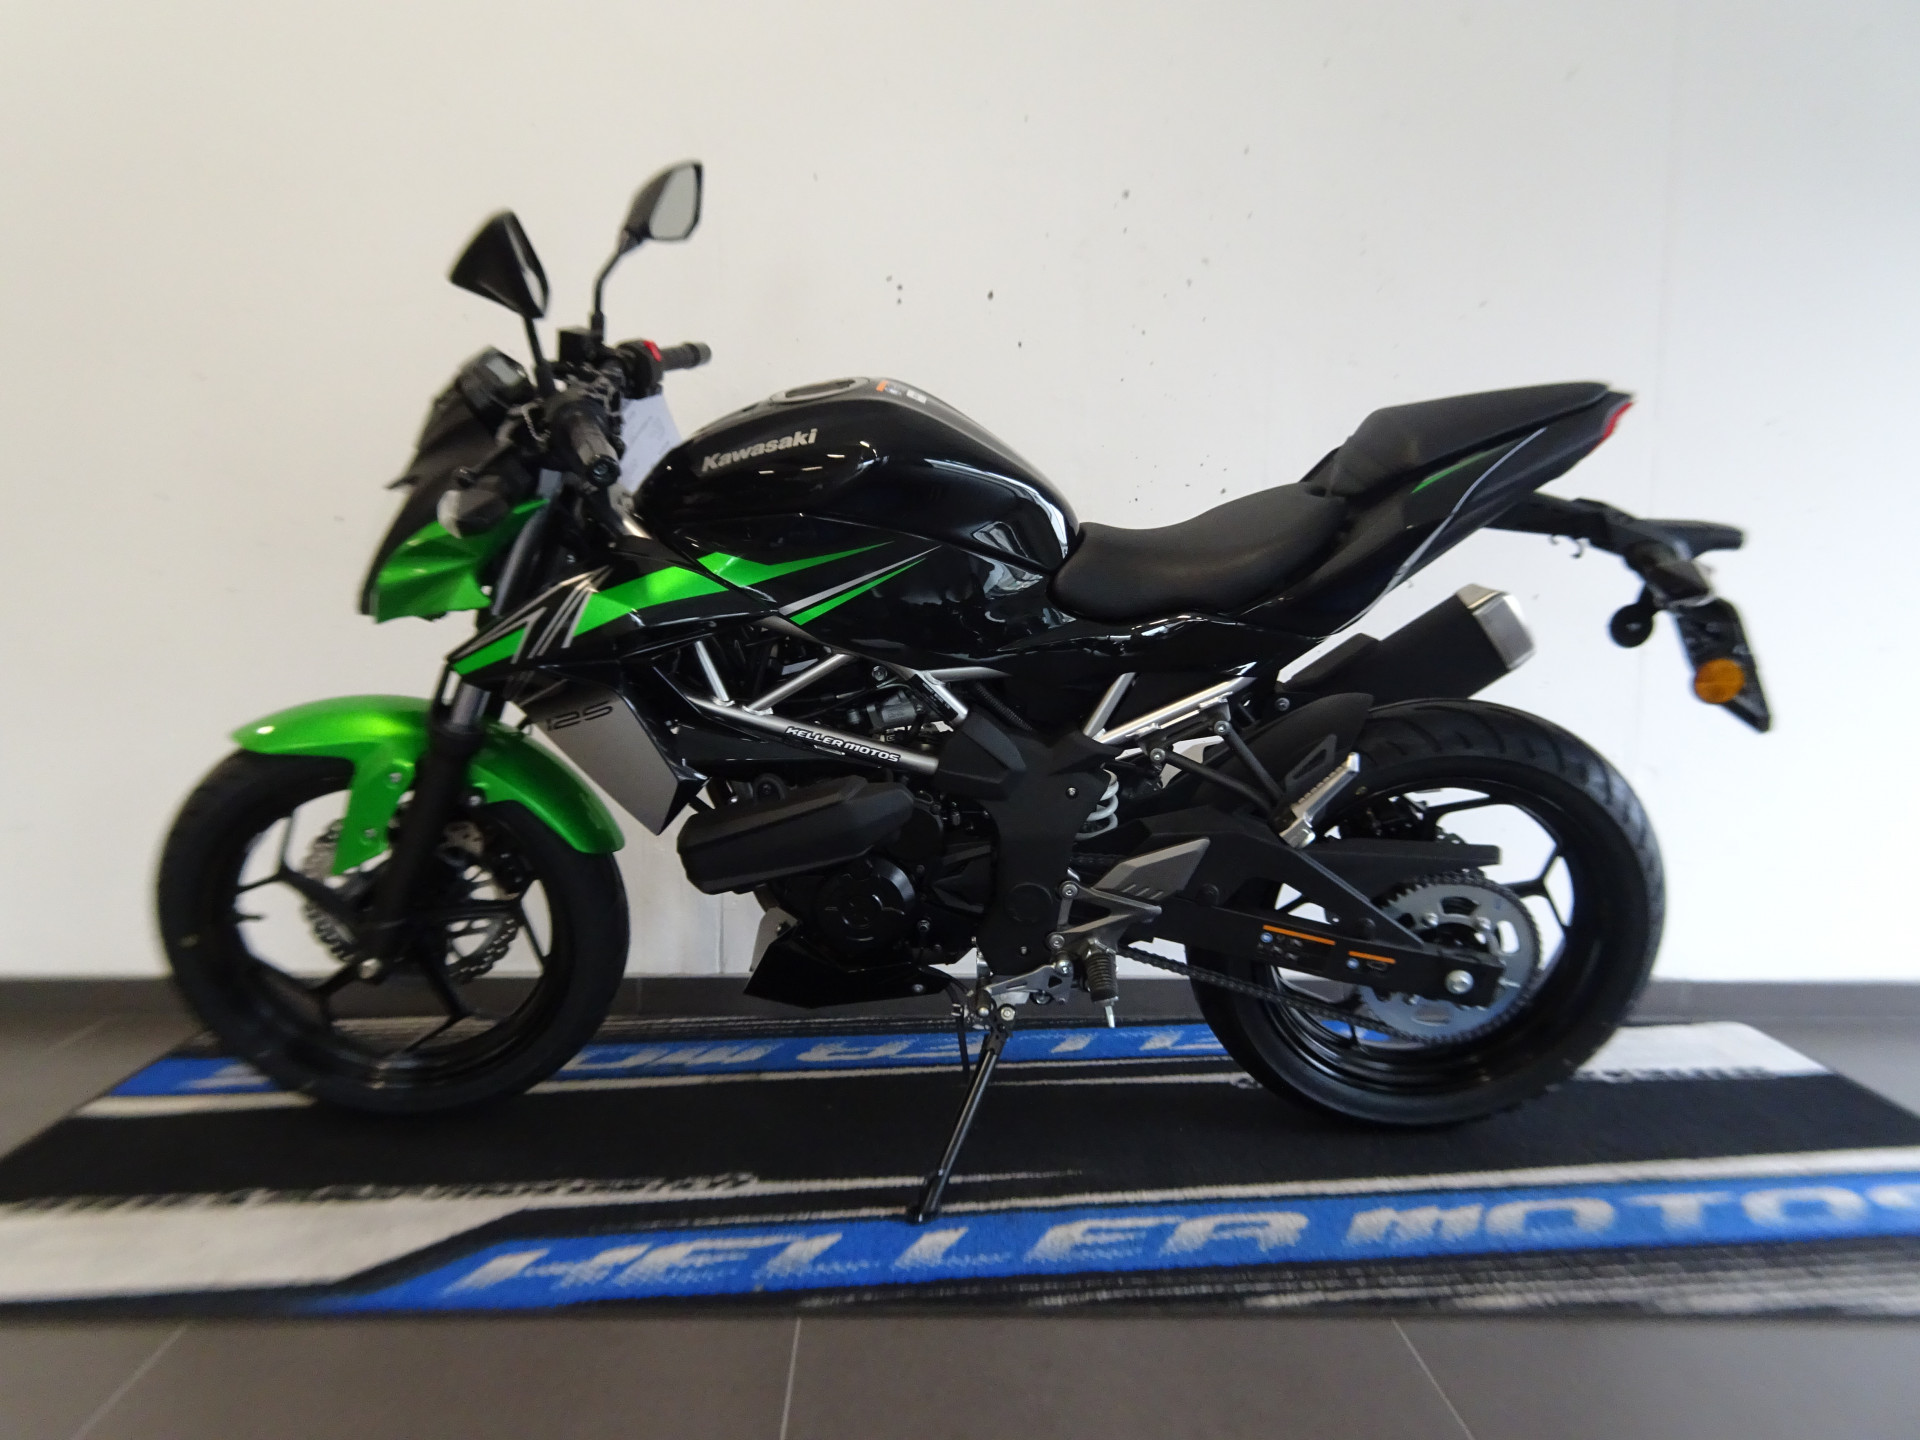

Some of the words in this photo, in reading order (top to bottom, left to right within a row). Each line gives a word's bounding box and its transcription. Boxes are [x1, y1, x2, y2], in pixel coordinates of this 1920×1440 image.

[701, 428, 818, 472] Kawasaki
[546, 700, 613, 731] 125
[785, 727, 843, 747] KELLER
[844, 742, 901, 763] MOTOS
